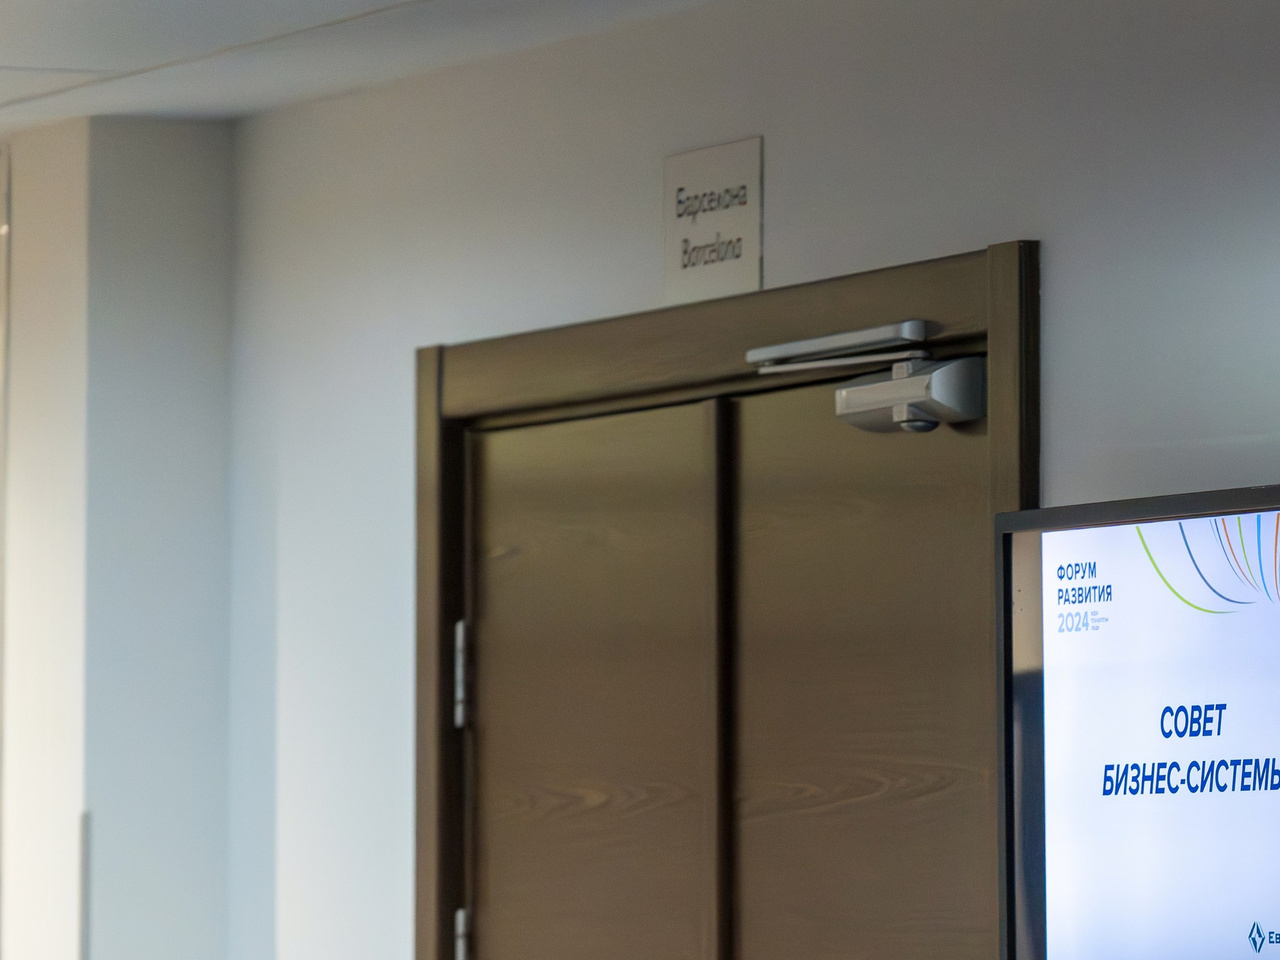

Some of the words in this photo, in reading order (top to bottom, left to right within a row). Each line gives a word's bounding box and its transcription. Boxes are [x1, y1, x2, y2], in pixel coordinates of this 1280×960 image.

[676, 184, 748, 224] Барселона
[682, 232, 743, 269] Barcelona
[1057, 561, 1097, 581] ФОРУМ
[1057, 584, 1113, 606] РАЗВИТИЯ
[1057, 611, 1089, 633] 2024
[1160, 703, 1227, 739] СОВЕТ
